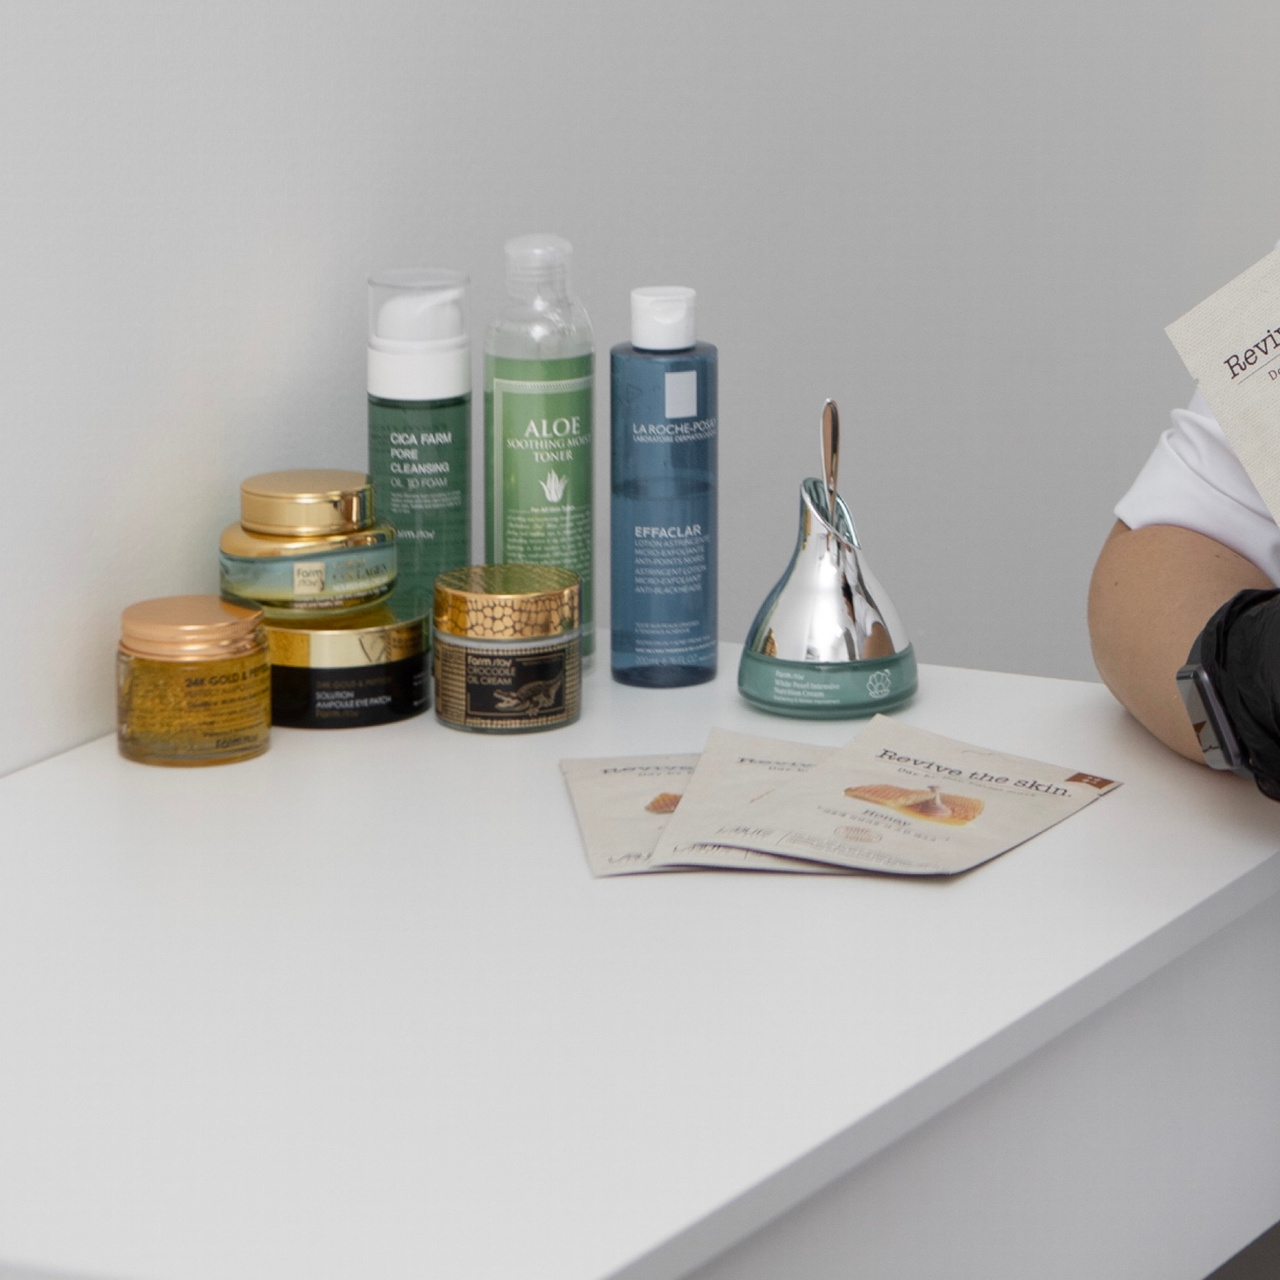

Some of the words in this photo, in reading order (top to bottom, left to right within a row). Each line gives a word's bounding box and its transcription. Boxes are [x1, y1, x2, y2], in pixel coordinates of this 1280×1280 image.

[524, 416, 581, 438] ALOE
[632, 423, 647, 434] LA
[390, 432, 418, 446] CICA
[420, 431, 452, 446] FARM
[506, 438, 566, 451] SOOTHING
[390, 448, 418, 460] PORE
[533, 449, 574, 463] TONER
[390, 461, 450, 475] CLEANSING
[634, 524, 702, 539] EFFACLAR
[467, 666, 517, 677] CROCODILE
[208, 673, 240, 686] GOLD
[480, 677, 512, 686] CREAM
[875, 748, 963, 778] Revive
[969, 771, 1009, 786] the
[1013, 779, 1073, 799] skin.
